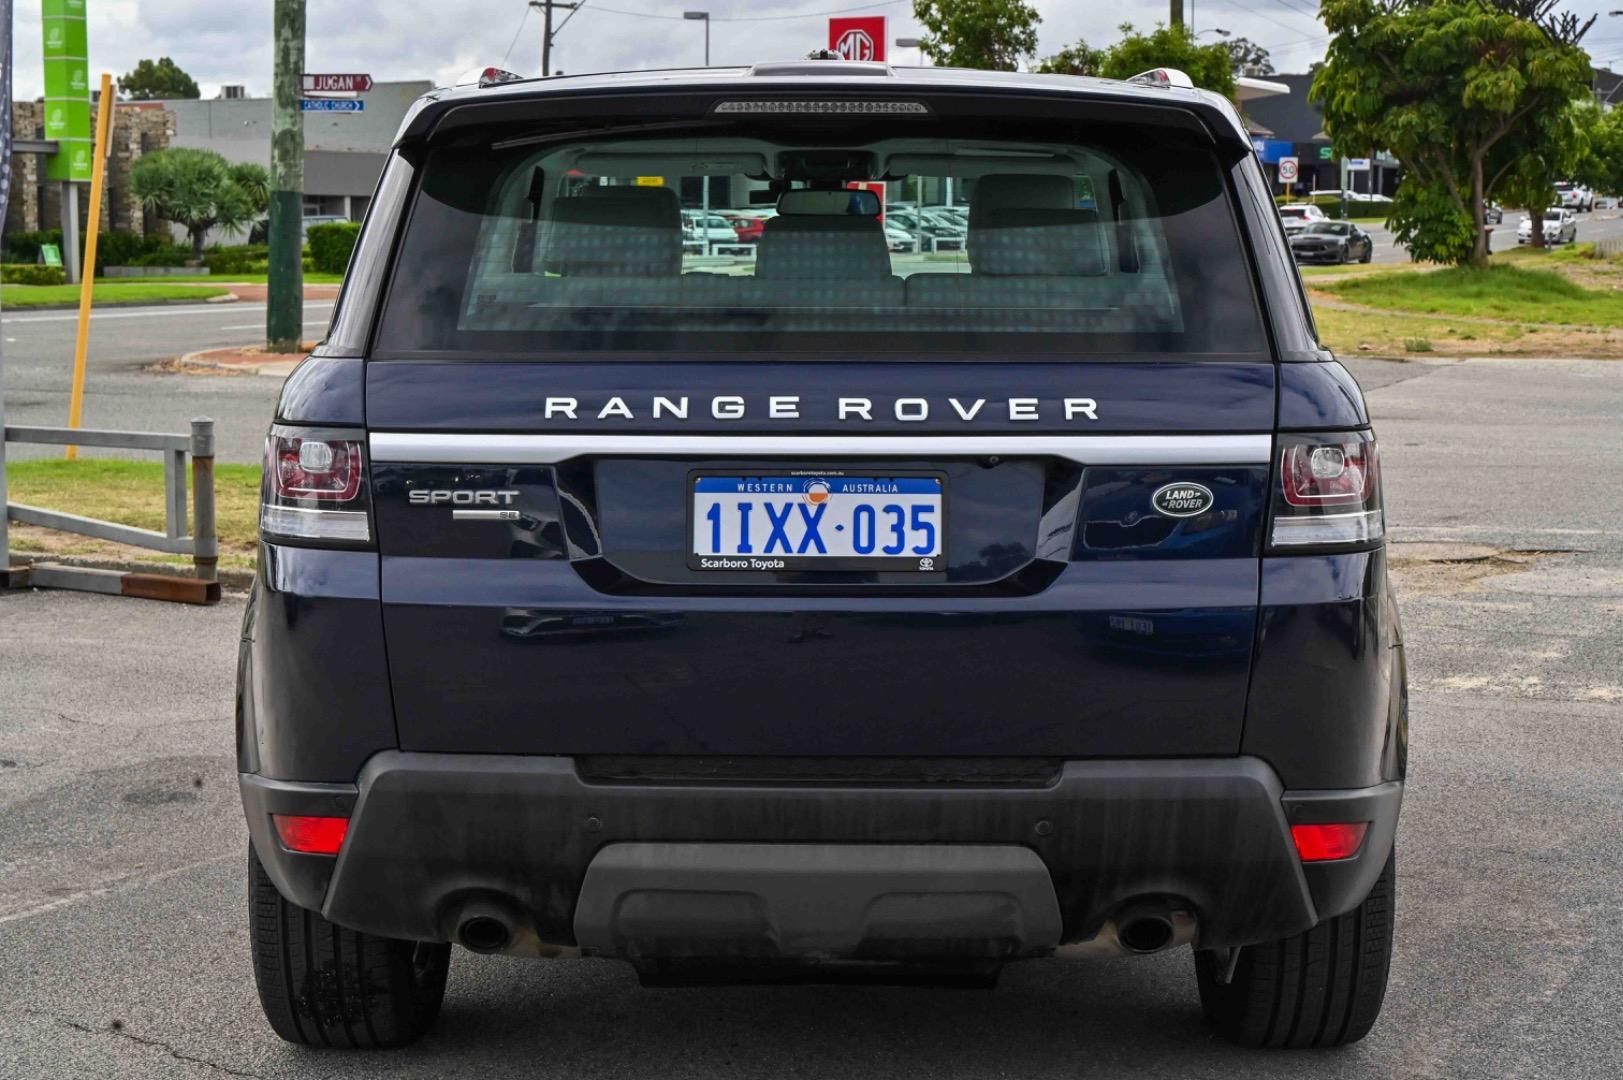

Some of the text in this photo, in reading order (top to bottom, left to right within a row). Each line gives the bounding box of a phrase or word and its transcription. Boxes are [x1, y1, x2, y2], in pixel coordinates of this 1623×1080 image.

[839, 32, 872, 61] MG
[315, 76, 353, 90] JUGAN
[1282, 165, 1294, 175] 50
[544, 396, 1099, 421] RANGE ROVER
[737, 484, 899, 493] WESTERN AUSTRALIA
[408, 490, 520, 504] SPORT
[1165, 490, 1195, 500] LAND
[1168, 499, 1203, 509] ROVER
[499, 511, 518, 519] SE
[701, 558, 785, 570] Scarboro Toyota
